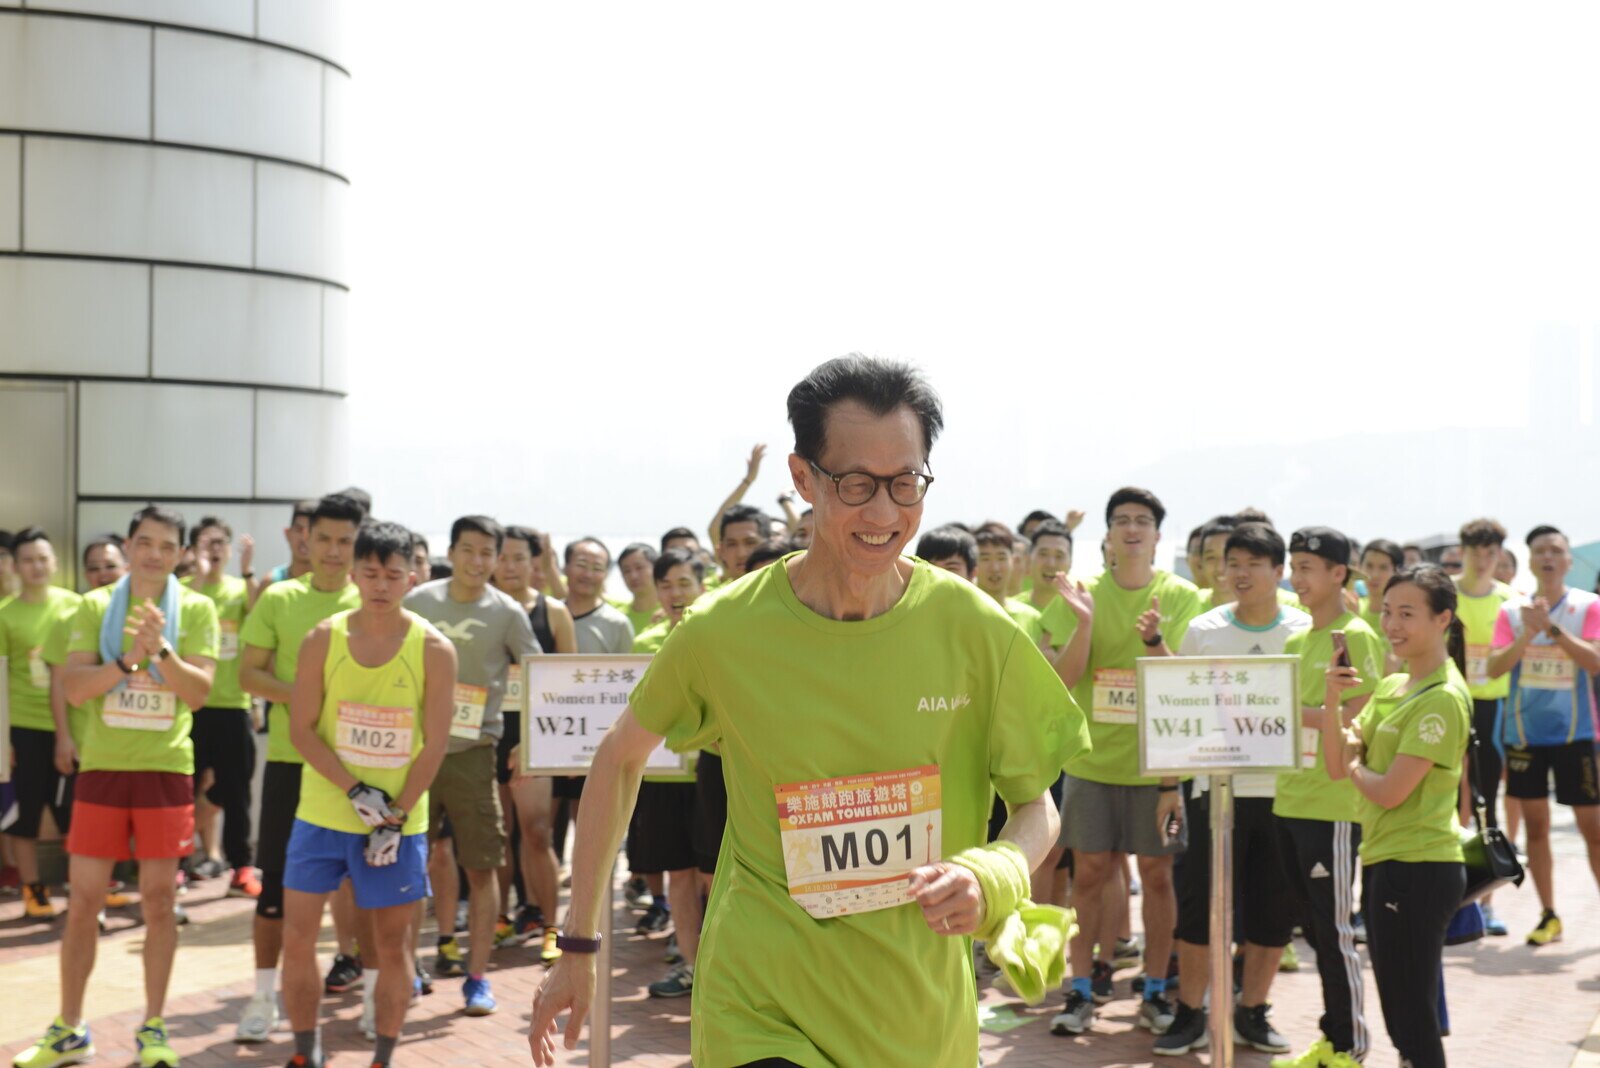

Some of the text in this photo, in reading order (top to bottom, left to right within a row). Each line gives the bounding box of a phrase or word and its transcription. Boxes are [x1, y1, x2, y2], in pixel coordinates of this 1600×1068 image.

[572, 668, 637, 684] 女子全塔
[1186, 671, 1250, 686] 女子全塔
[119, 691, 162, 712] M03
[542, 692, 628, 705] Women Full
[917, 696, 948, 711] AIA
[1158, 693, 1280, 707] Women Full Race
[536, 716, 587, 736] W21
[1152, 718, 1204, 737] W41
[1233, 717, 1286, 736] W68
[351, 727, 396, 749] M02
[786, 783, 907, 813] 樂施競跑旅遊塔
[788, 811, 834, 825] OXFAM
[837, 801, 908, 821] TOWERRUN
[821, 824, 911, 872] M01
